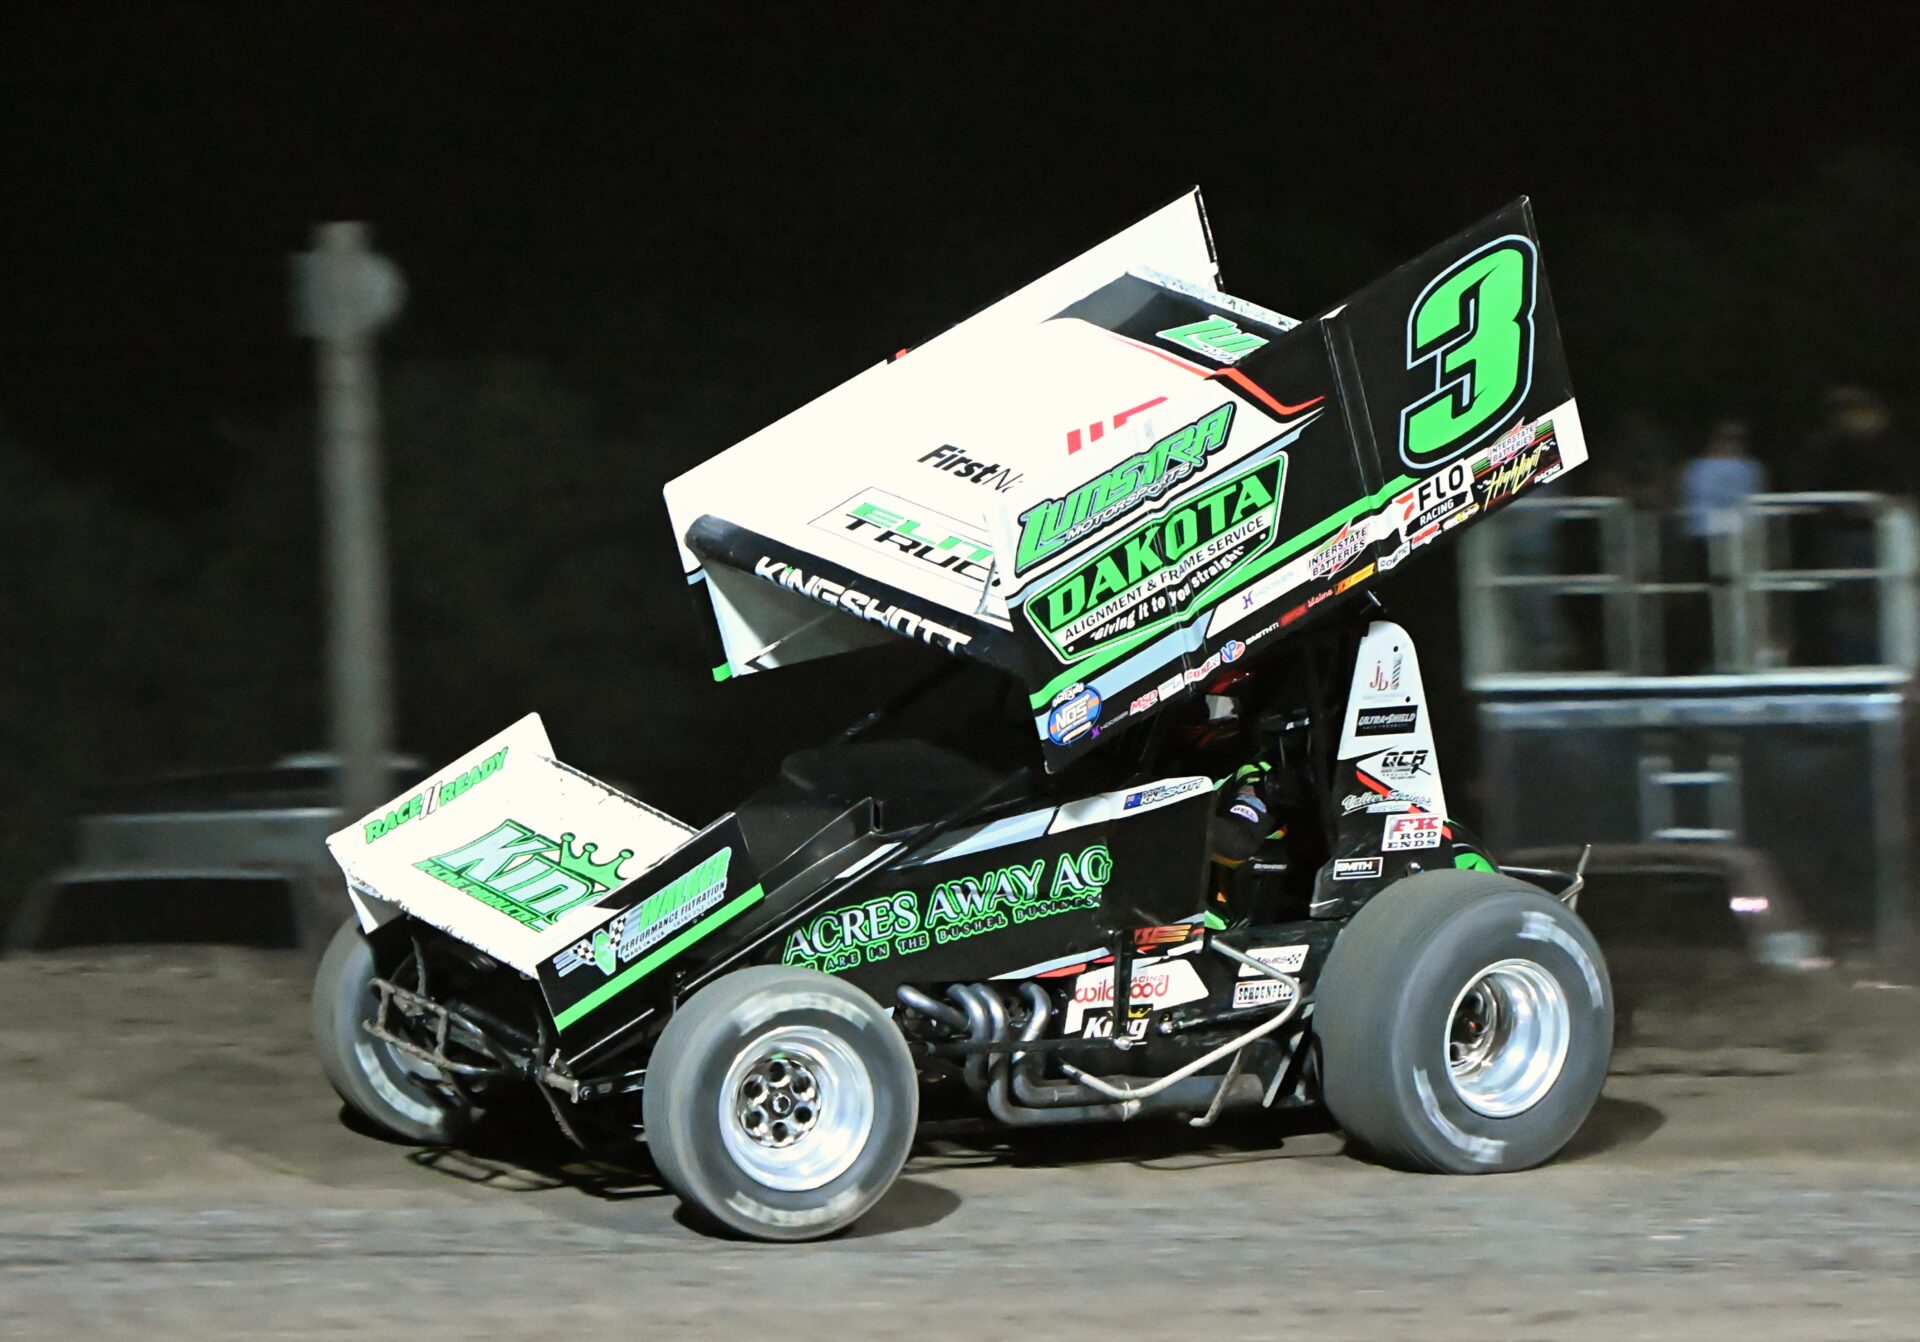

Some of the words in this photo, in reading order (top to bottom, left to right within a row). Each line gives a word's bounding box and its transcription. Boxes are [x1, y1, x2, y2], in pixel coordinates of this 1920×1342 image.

[1400, 235, 1537, 469] 3
[1490, 426, 1535, 455] INTERSTATE
[1492, 435, 1533, 463] BATTERIES
[1418, 464, 1464, 511] FLO
[1534, 465, 1561, 484] RACING
[1066, 462, 1191, 540] MOTORSPORTS
[1419, 499, 1455, 527] RACING
[845, 513, 1001, 588] TRUC
[1047, 474, 1273, 630] DAKOTA
[1308, 527, 1368, 569] INTERSTATE
[1312, 541, 1366, 576] BATTERIES
[1065, 586, 1142, 641] ALIGNMENT
[1147, 579, 1158, 592] &
[1160, 550, 1205, 584] FRAME
[1207, 516, 1264, 555] SERVICE
[1152, 593, 1166, 612] to
[1168, 585, 1191, 612] you
[1221, 640, 1238, 662] VP
[1055, 694, 1090, 733] NOS
[1131, 689, 1159, 713] MSD
[363, 794, 425, 844] RACE
[439, 746, 509, 808] READY
[1392, 817, 1439, 832] FK
[1400, 831, 1437, 840] ROD
[1388, 840, 1436, 849] ENDS
[619, 909, 679, 954] PERFORMANCE
[680, 880, 726, 915] FILTRATION
[783, 891, 919, 964] ACRES
[926, 860, 1044, 928] AWAY
[827, 953, 857, 969] ARE
[870, 945, 887, 960] IN
[900, 935, 927, 951] THE
[939, 916, 1005, 941] BUSHEL
[1017, 894, 1102, 919] BUSINES
[1131, 974, 1165, 983] ACING
[1082, 1016, 1150, 1041] Kig
